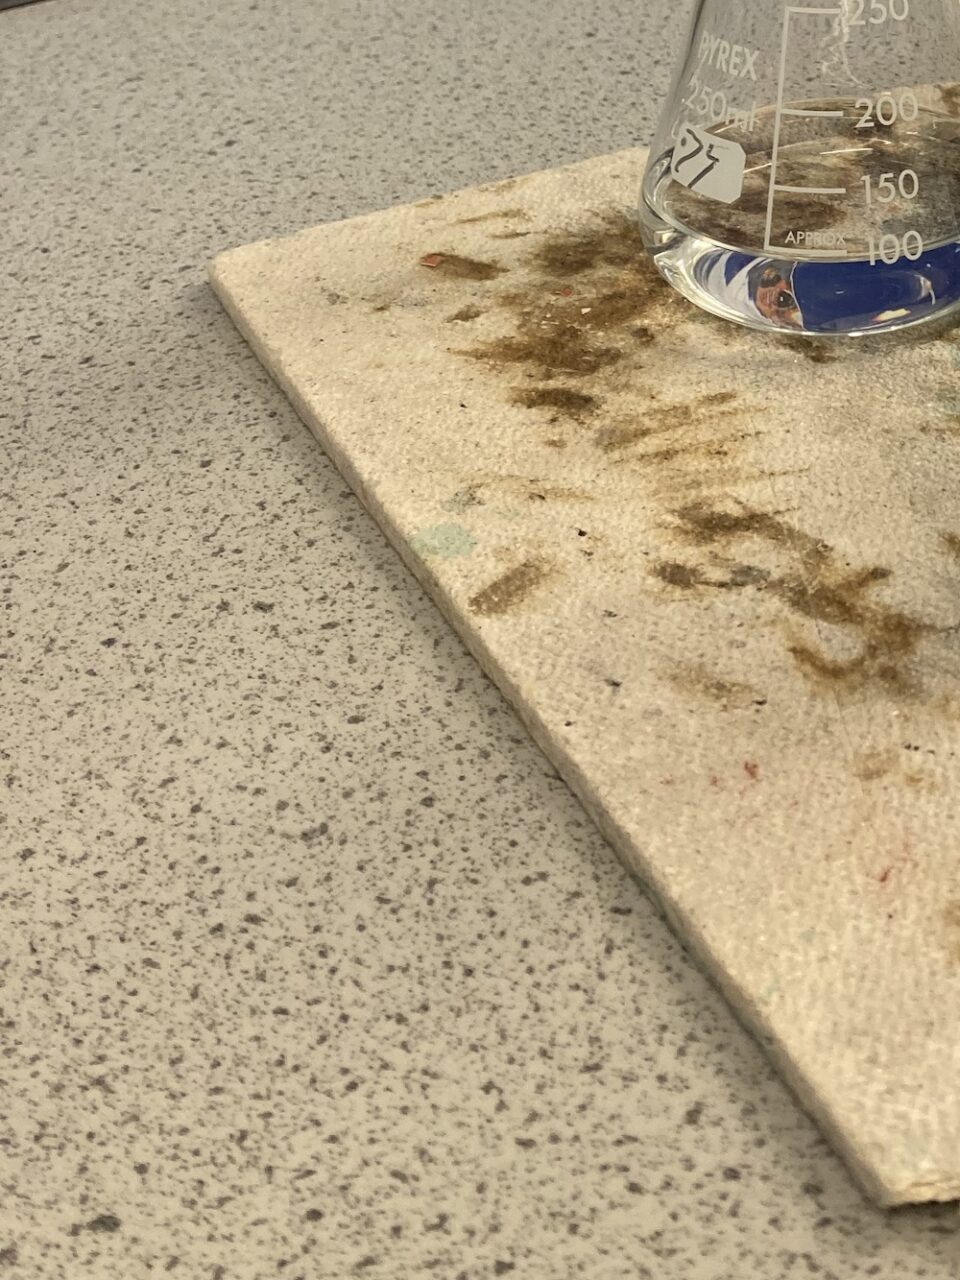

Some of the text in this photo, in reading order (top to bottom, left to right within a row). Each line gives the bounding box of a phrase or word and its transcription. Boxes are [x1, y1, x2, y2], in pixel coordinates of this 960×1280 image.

[698, 30, 760, 81] PYREX
[855, 94, 918, 129] 200
[860, 169, 919, 206] 150
[785, 230, 847, 247] APPROX
[865, 230, 923, 266] 100
